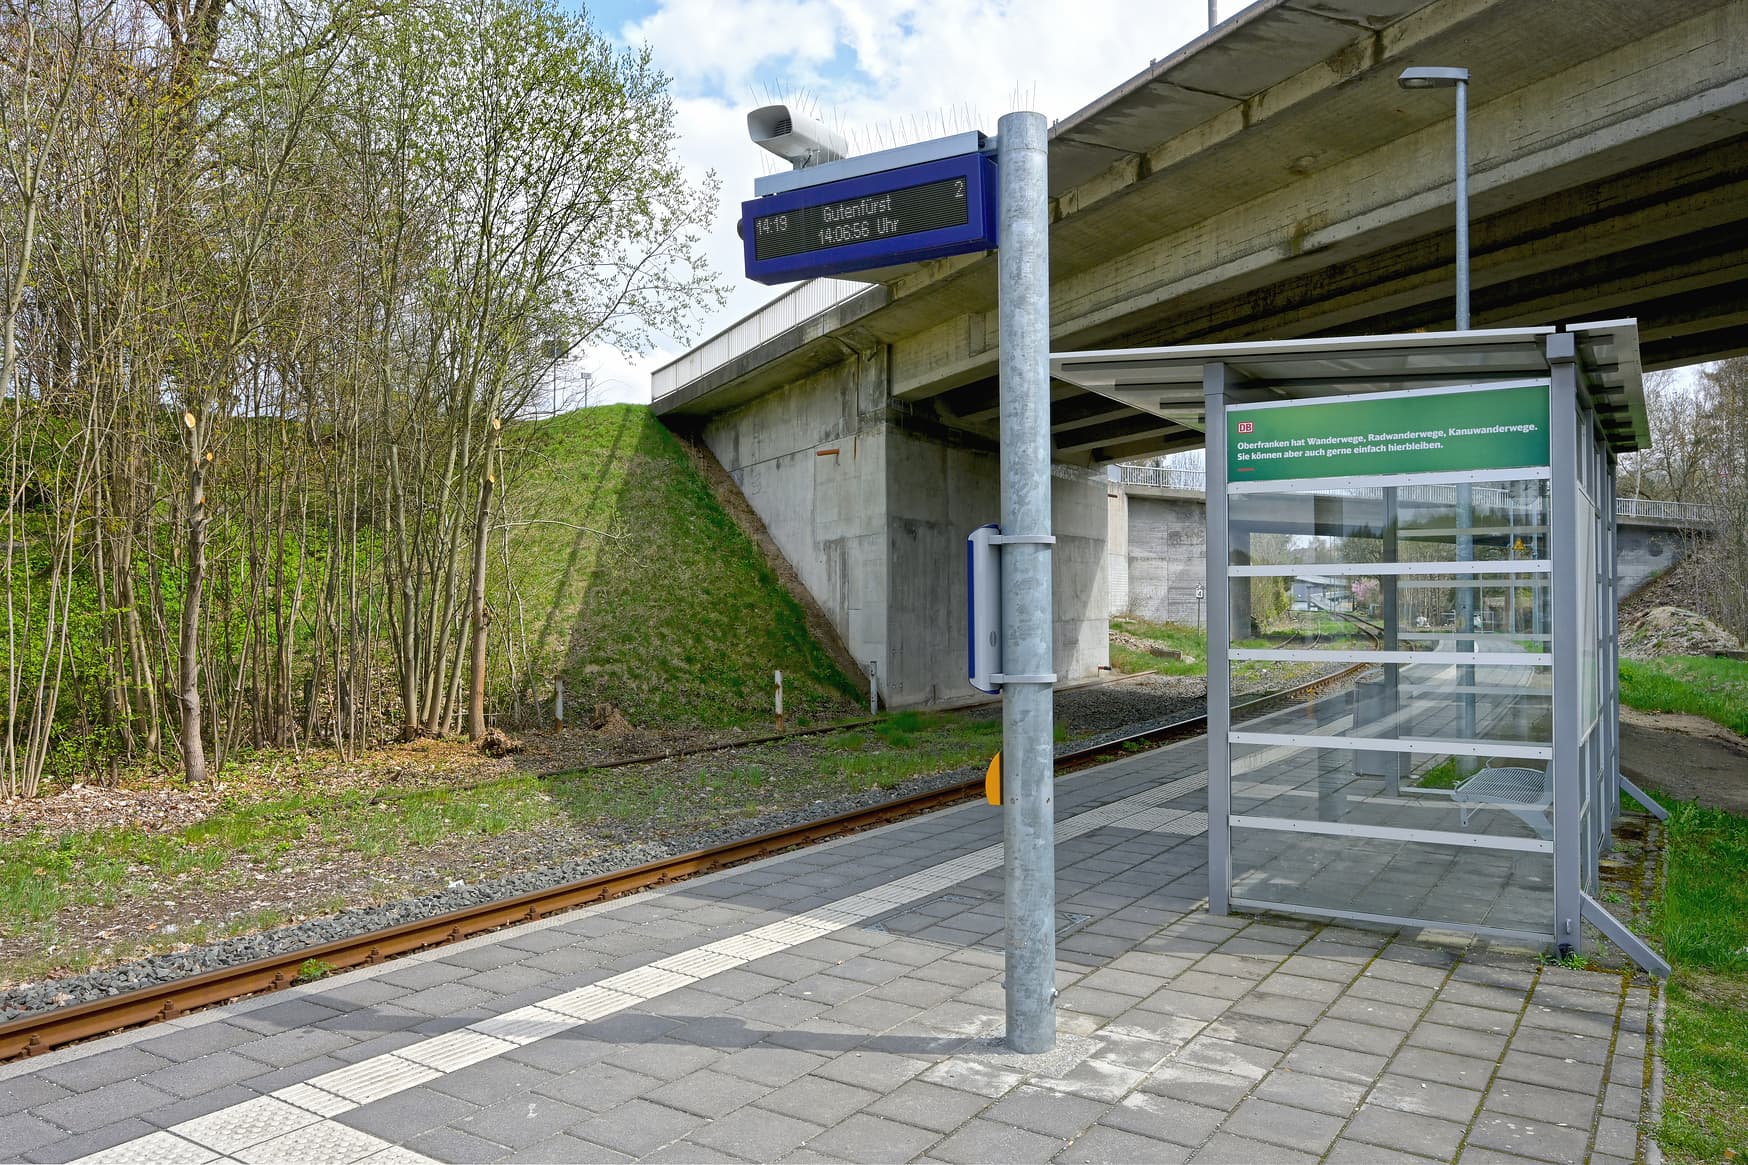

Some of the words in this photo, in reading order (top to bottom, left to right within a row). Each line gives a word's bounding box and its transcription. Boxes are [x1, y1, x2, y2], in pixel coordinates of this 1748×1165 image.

[954, 180, 964, 199] 2
[823, 194, 892, 223] Gutenfürst
[756, 215, 788, 235] 14:19
[877, 217, 899, 234] Uhr
[1237, 439, 1289, 450] Oberfranken
[1291, 439, 1305, 447] hat
[1307, 434, 1366, 445] Wanderwege,
[1368, 430, 1446, 442] Radwanderwege,
[1448, 423, 1538, 436] Kanuwanderwege.
[1238, 422, 1253, 433] DB
[1237, 452, 1250, 461] Sie
[1251, 450, 1282, 460] können
[1283, 449, 1303, 458] aber
[1304, 448, 1326, 457] auch
[1326, 448, 1352, 457] gerne
[1353, 443, 1386, 454] einfach
[1388, 441, 1444, 452] hierbleiben.
